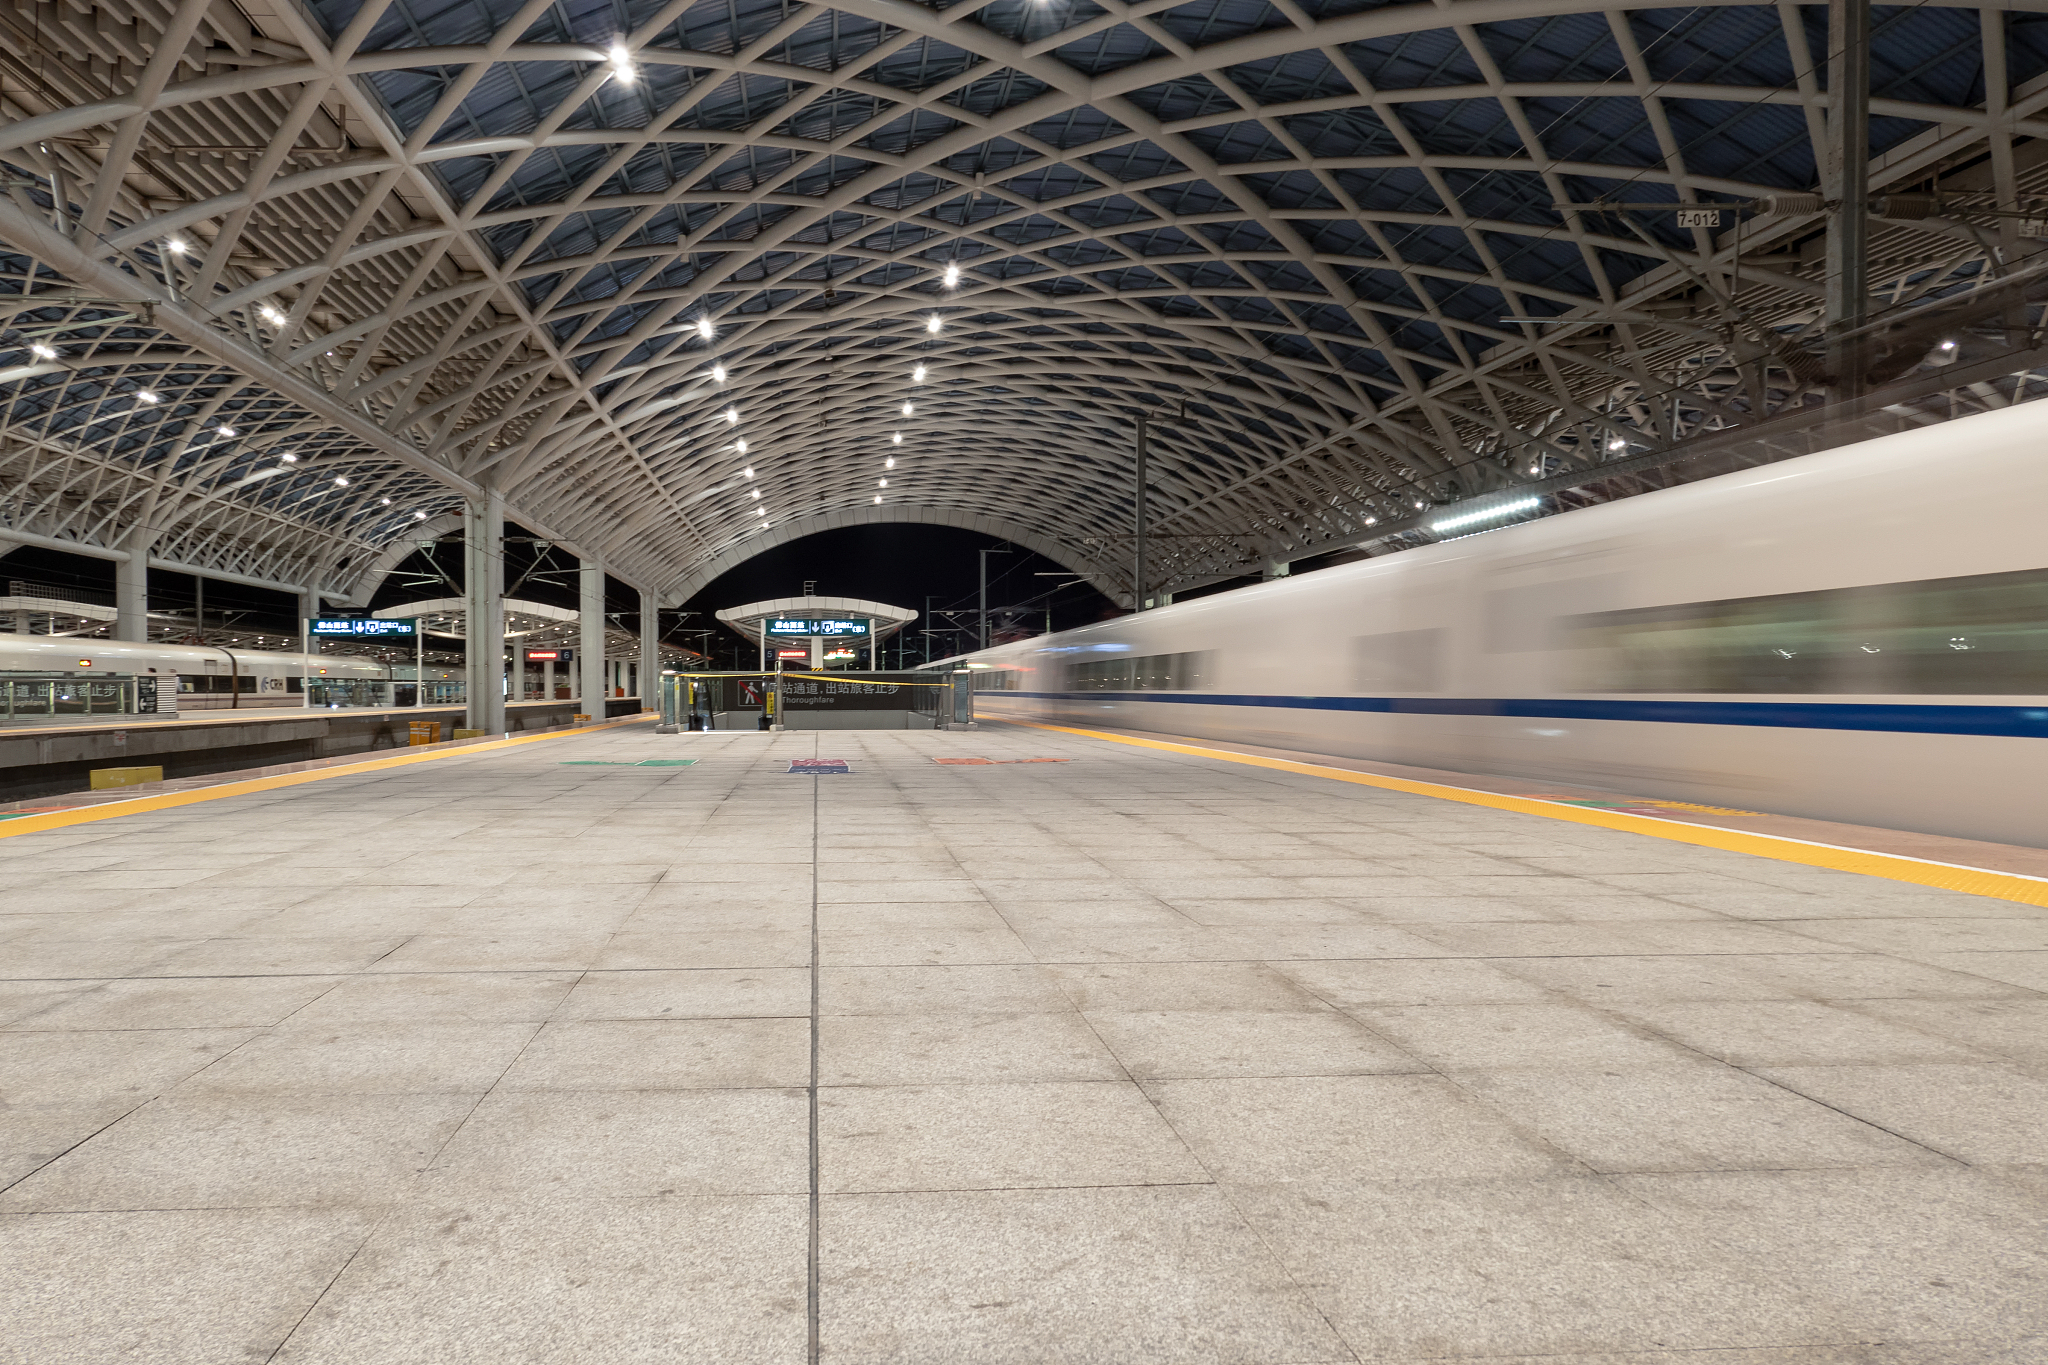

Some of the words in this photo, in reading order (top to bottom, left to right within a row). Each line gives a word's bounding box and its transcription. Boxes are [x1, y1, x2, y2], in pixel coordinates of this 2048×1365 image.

[1679, 213, 1718, 226] 7-012
[270, 679, 284, 690] CRH
[782, 696, 835, 705] Thoroughfare
